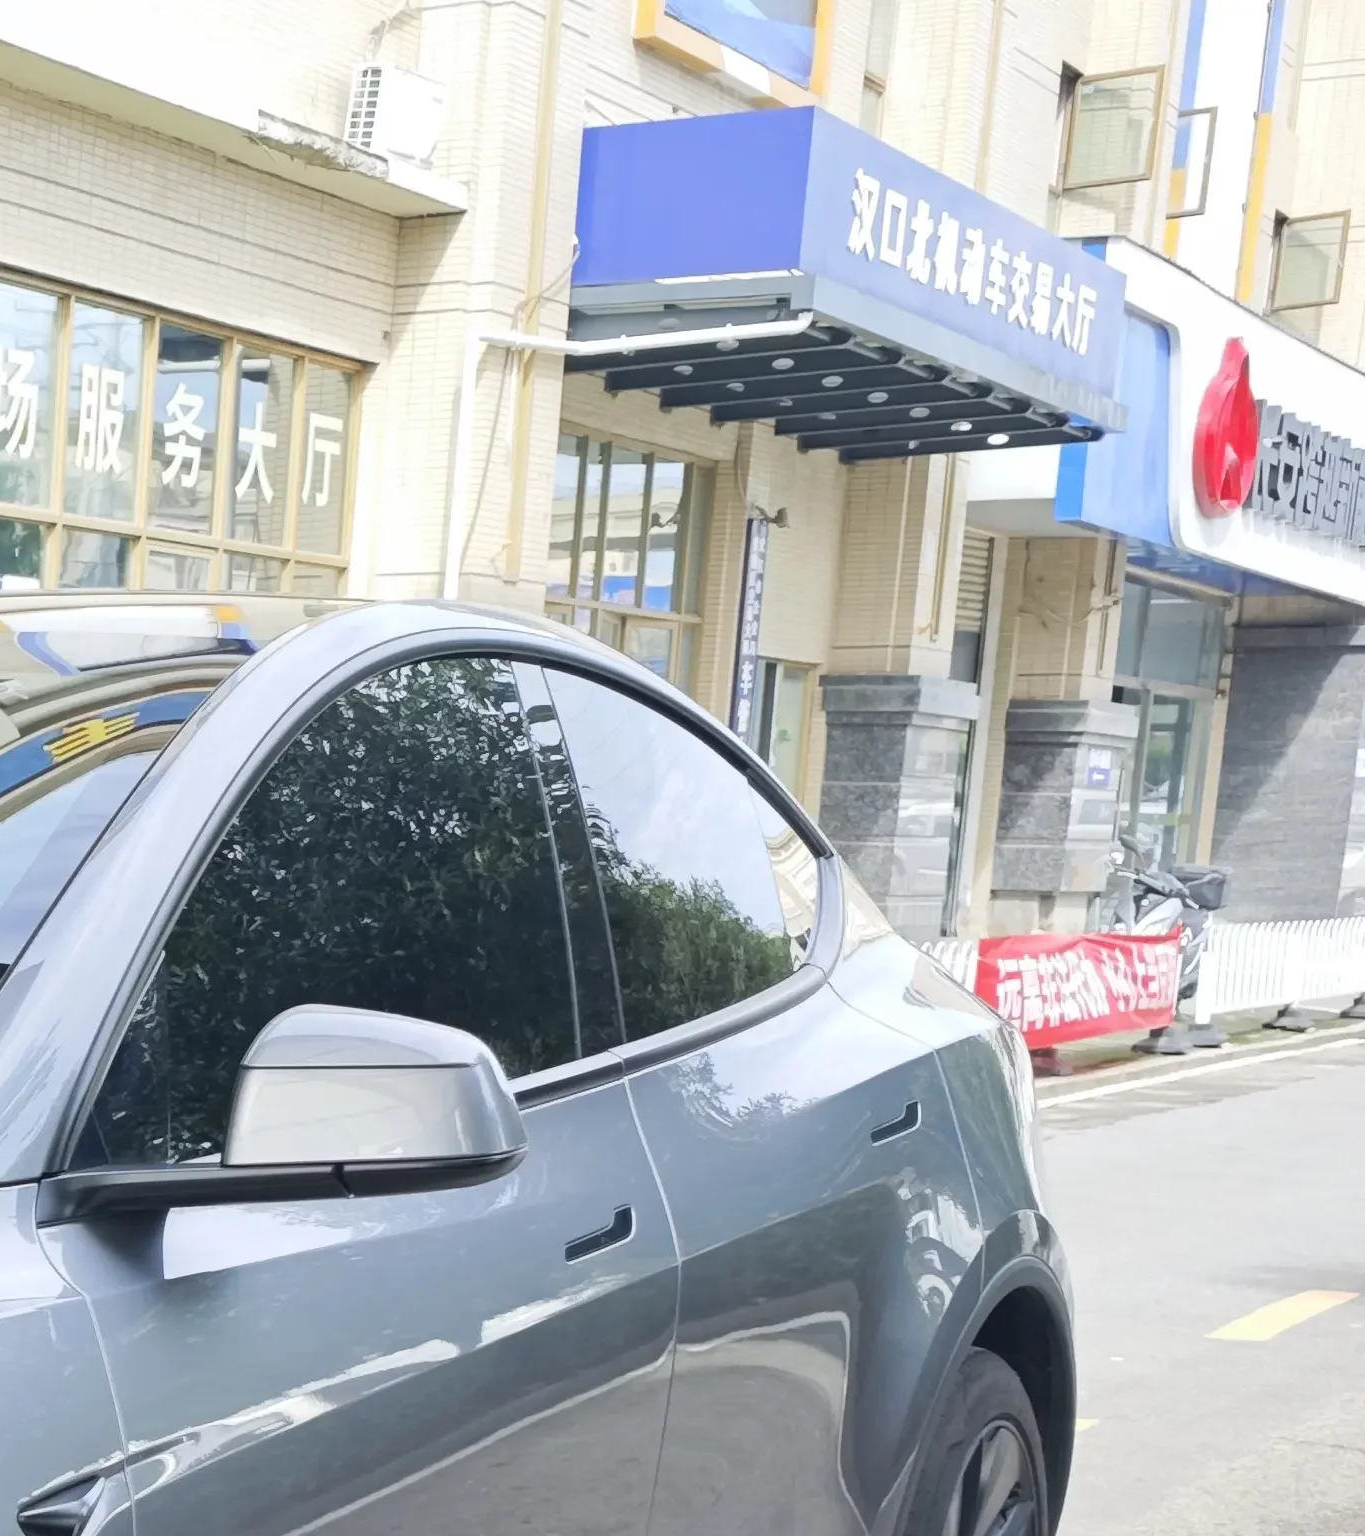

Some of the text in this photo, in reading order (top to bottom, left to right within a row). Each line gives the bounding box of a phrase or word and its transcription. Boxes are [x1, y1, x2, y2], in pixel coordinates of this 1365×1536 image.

[848, 167, 1098, 355] 汉口北机动车交易大厅
